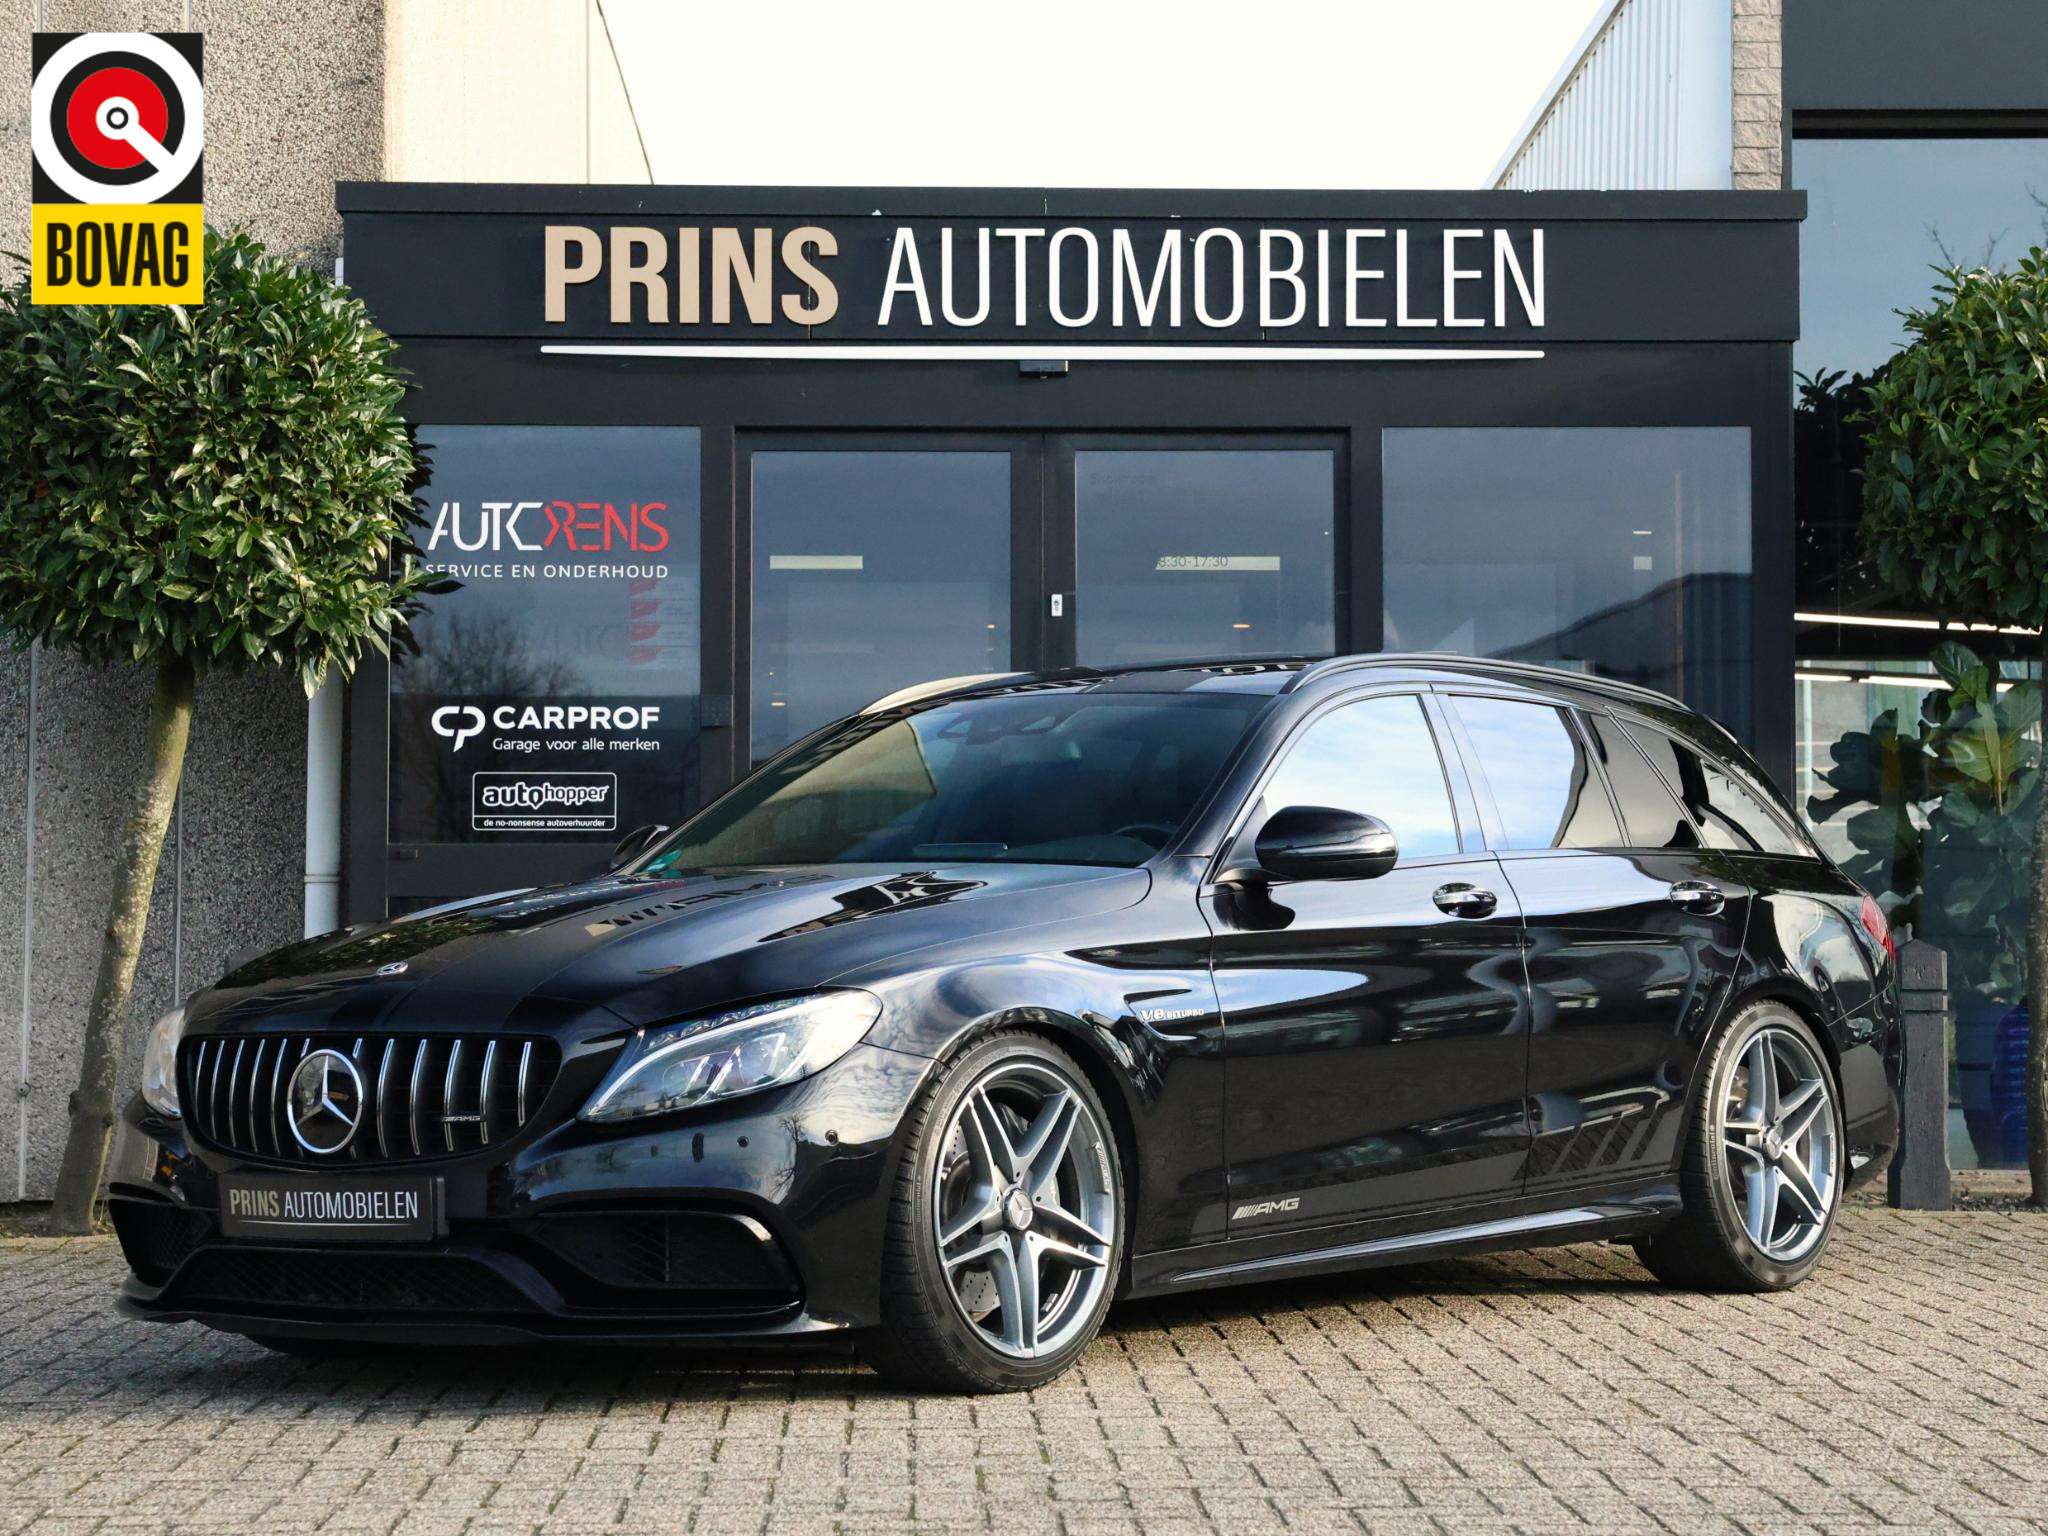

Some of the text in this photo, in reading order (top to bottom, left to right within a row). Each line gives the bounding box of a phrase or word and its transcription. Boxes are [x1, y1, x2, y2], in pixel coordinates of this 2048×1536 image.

[543, 225, 1546, 329] PRINS AUTOMOBIELEN
[425, 564, 669, 579] SERVICE EN ONDERHOUD
[492, 706, 661, 731] CARPROF
[492, 738, 660, 753] Garage voor alle merken
[483, 819, 605, 827] de no-nonsense autoverhuurder
[1141, 1009, 1164, 1021] V8
[229, 1189, 419, 1219] PRINS AUTOMOBIELEN
[1254, 1197, 1301, 1216] AMG
